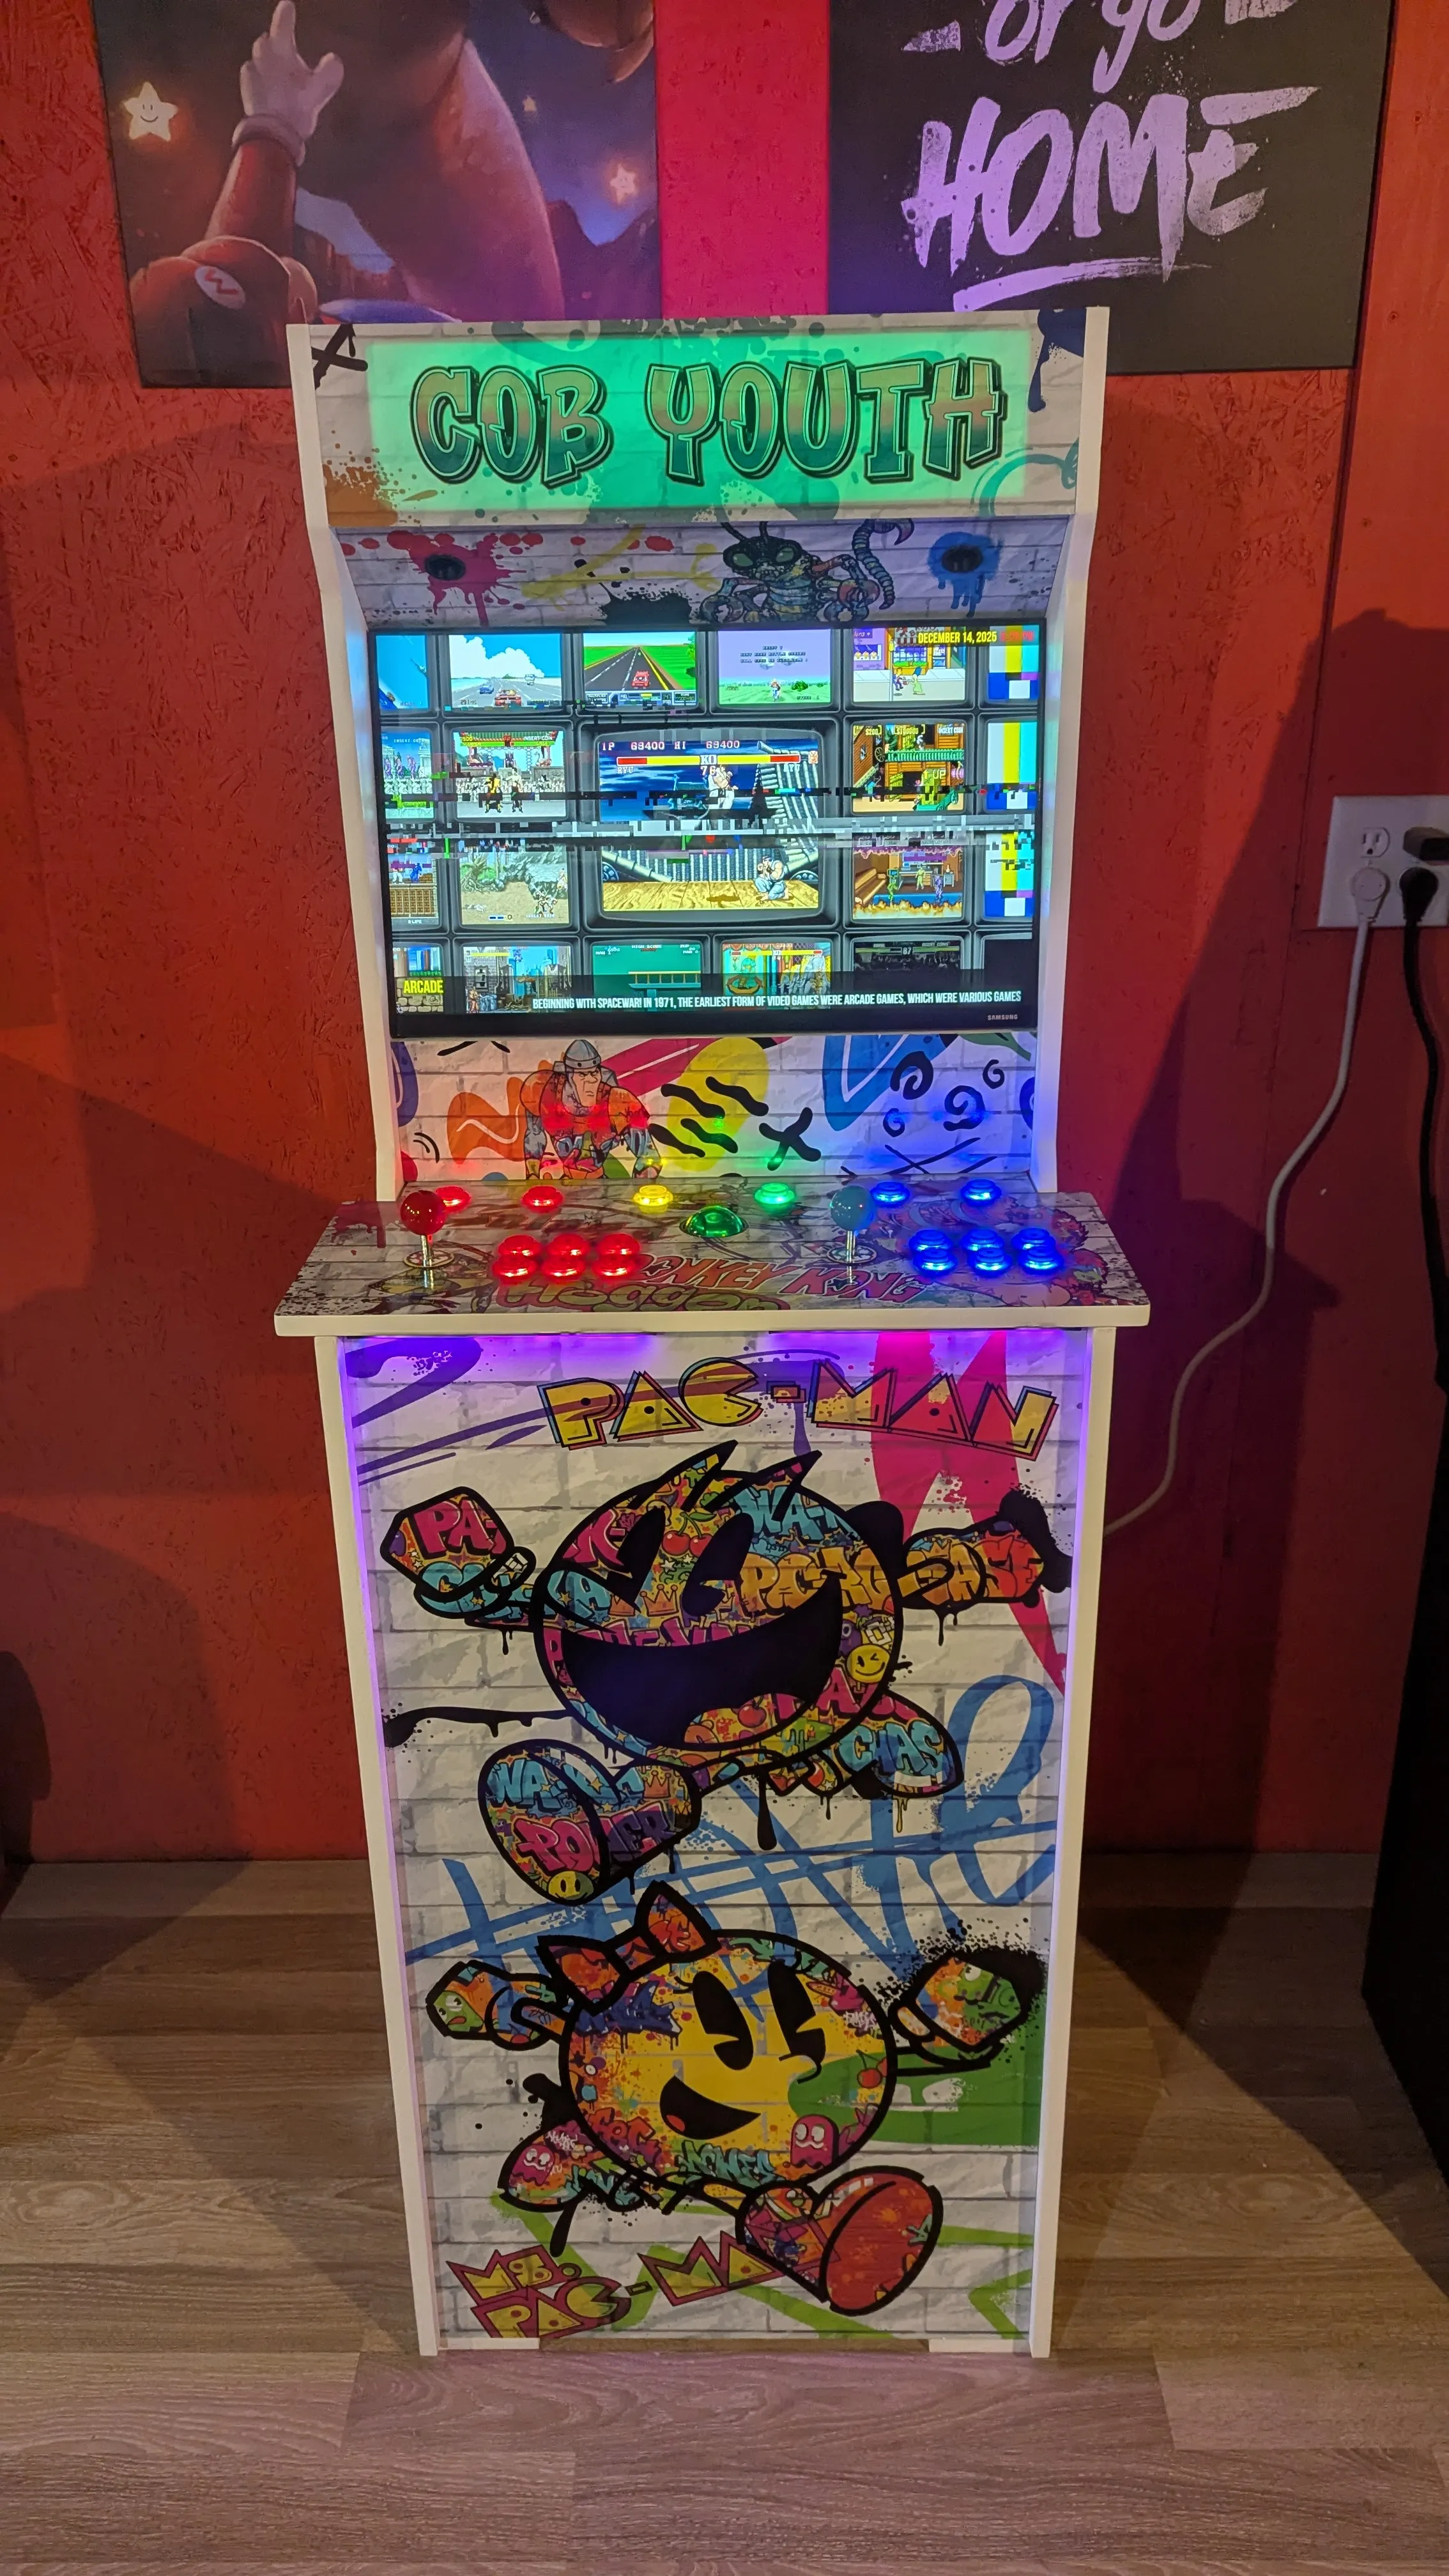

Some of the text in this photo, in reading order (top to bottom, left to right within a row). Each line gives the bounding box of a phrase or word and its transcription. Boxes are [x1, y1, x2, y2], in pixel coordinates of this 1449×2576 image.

[901, 86, 1321, 282] HOME
[410, 358, 1008, 489] COB YOUTH
[918, 631, 960, 644] DECEMBER
[963, 632, 976, 644] 14,
[976, 631, 997, 643] 2025
[630, 741, 665, 751] 69400
[706, 740, 740, 749] 69400
[700, 755, 717, 765] KO
[404, 979, 444, 993] ARCADE
[533, 990, 1021, 1009] BEGINNING WITH SPACEWAR! IN 1971, THE EARLIEST FORM OF VIDEO GAMES WERE ARCADE GAMES, WHICH WERE VARIOUS GAMES
[537, 1357, 1059, 1462] PAC-MAN
